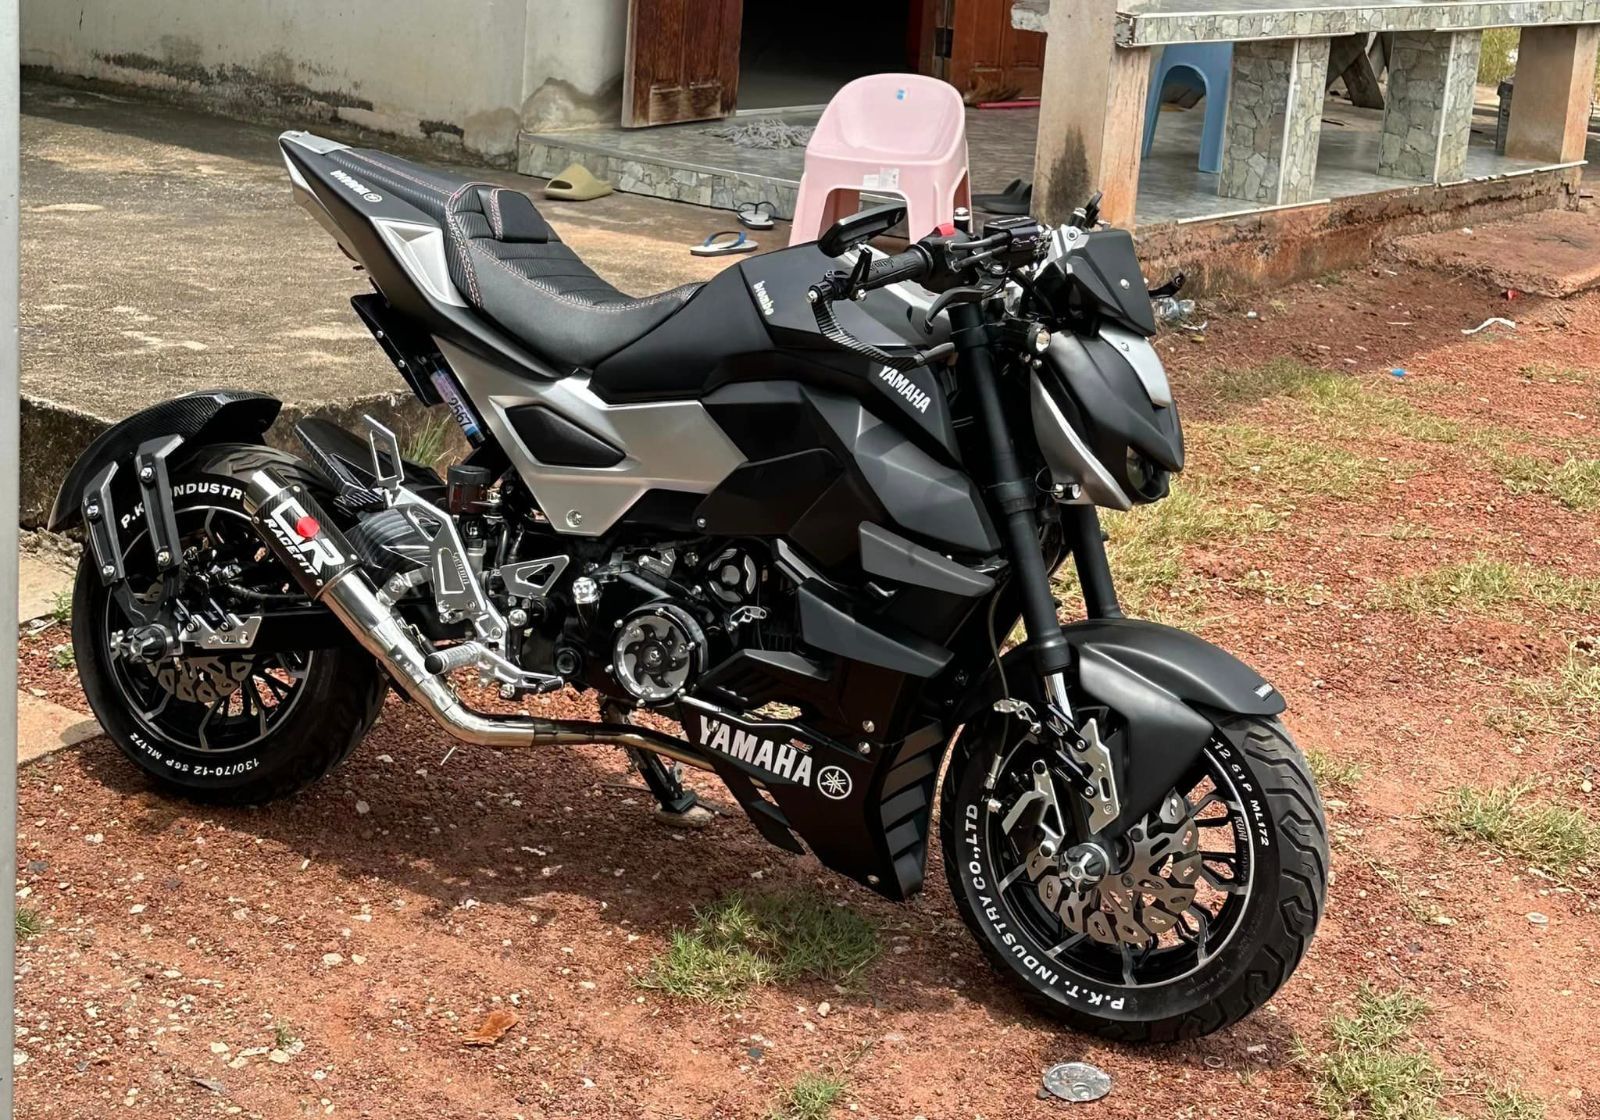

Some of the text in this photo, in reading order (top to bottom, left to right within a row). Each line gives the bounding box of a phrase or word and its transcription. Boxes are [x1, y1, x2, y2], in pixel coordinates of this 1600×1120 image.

[753, 280, 775, 316] brembo
[879, 365, 932, 414] YAMAHA
[448, 397, 473, 427] 2567
[173, 482, 246, 501] NDUSTR
[263, 518, 319, 576] RACEFIT
[129, 732, 163, 760] ML172
[700, 714, 813, 788] YAMAHA
[193, 758, 260, 777] 130/70-12
[1250, 799, 1270, 847] ML172
[965, 804, 1126, 1010] P.K.T. INDUSTRY CO.,LTD
